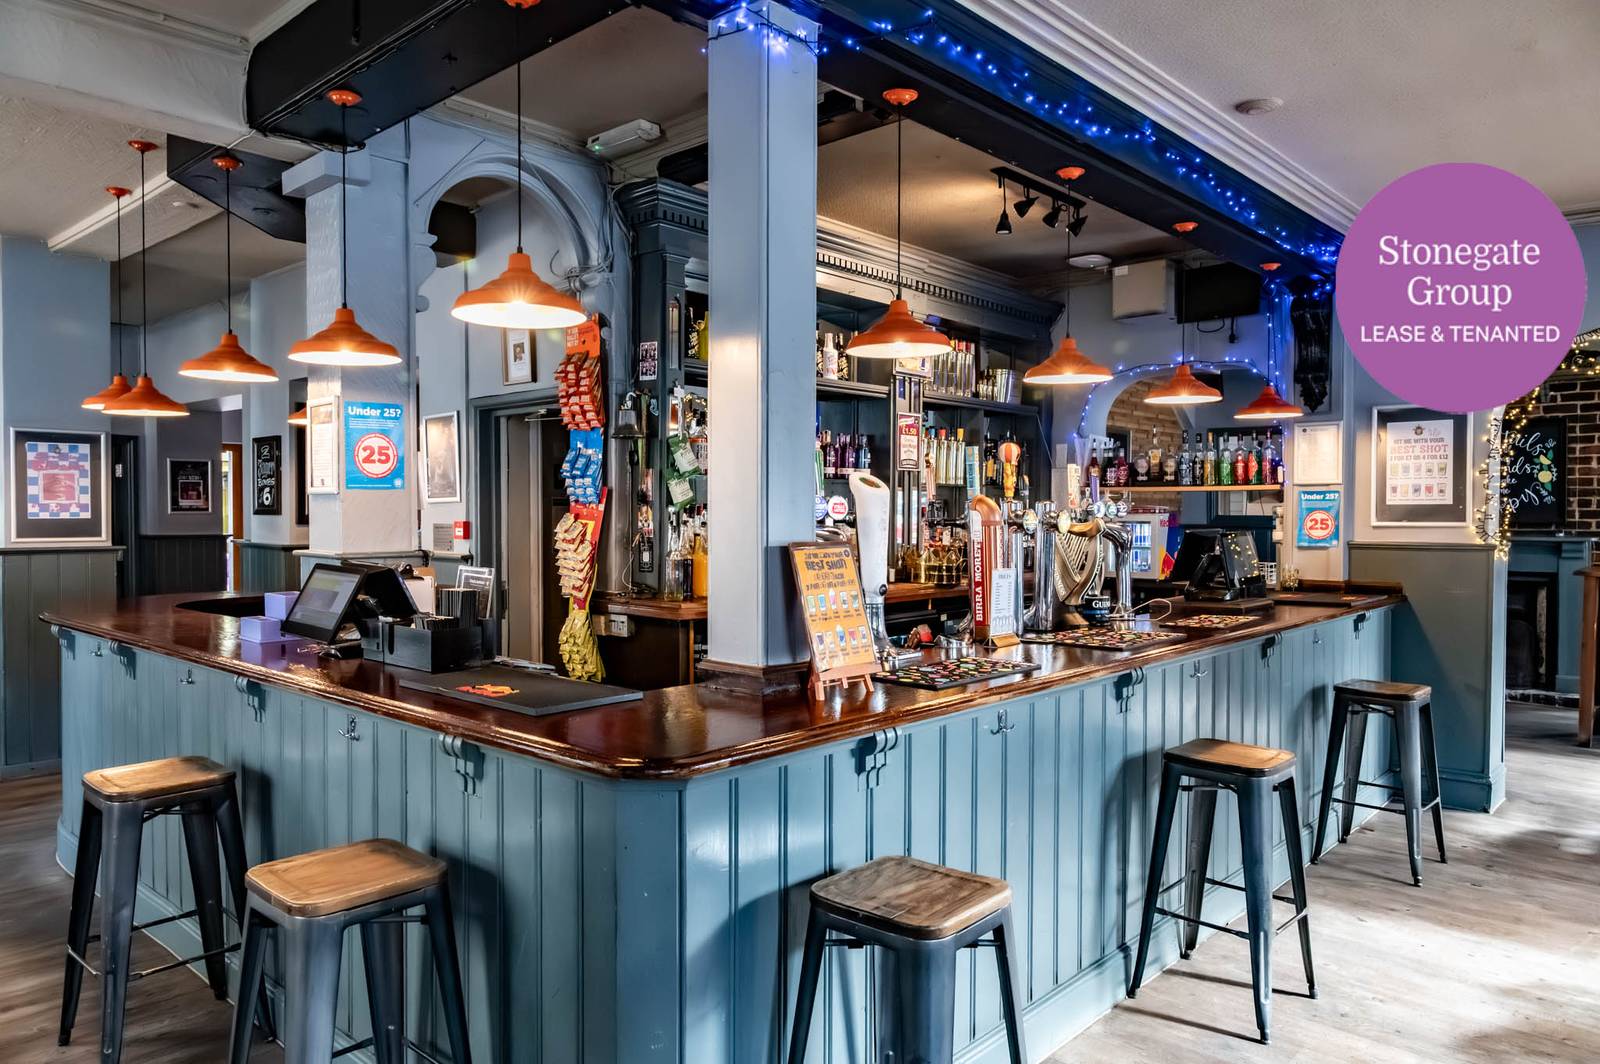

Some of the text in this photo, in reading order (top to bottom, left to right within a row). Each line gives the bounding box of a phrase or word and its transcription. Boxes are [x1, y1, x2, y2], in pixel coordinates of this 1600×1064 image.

[348, 406, 402, 418] Under 25?
[361, 445, 391, 465] 25
[1419, 444, 1449, 454] SHOT
[1308, 518, 1330, 531] 25
[974, 586, 984, 622] BIRRA
